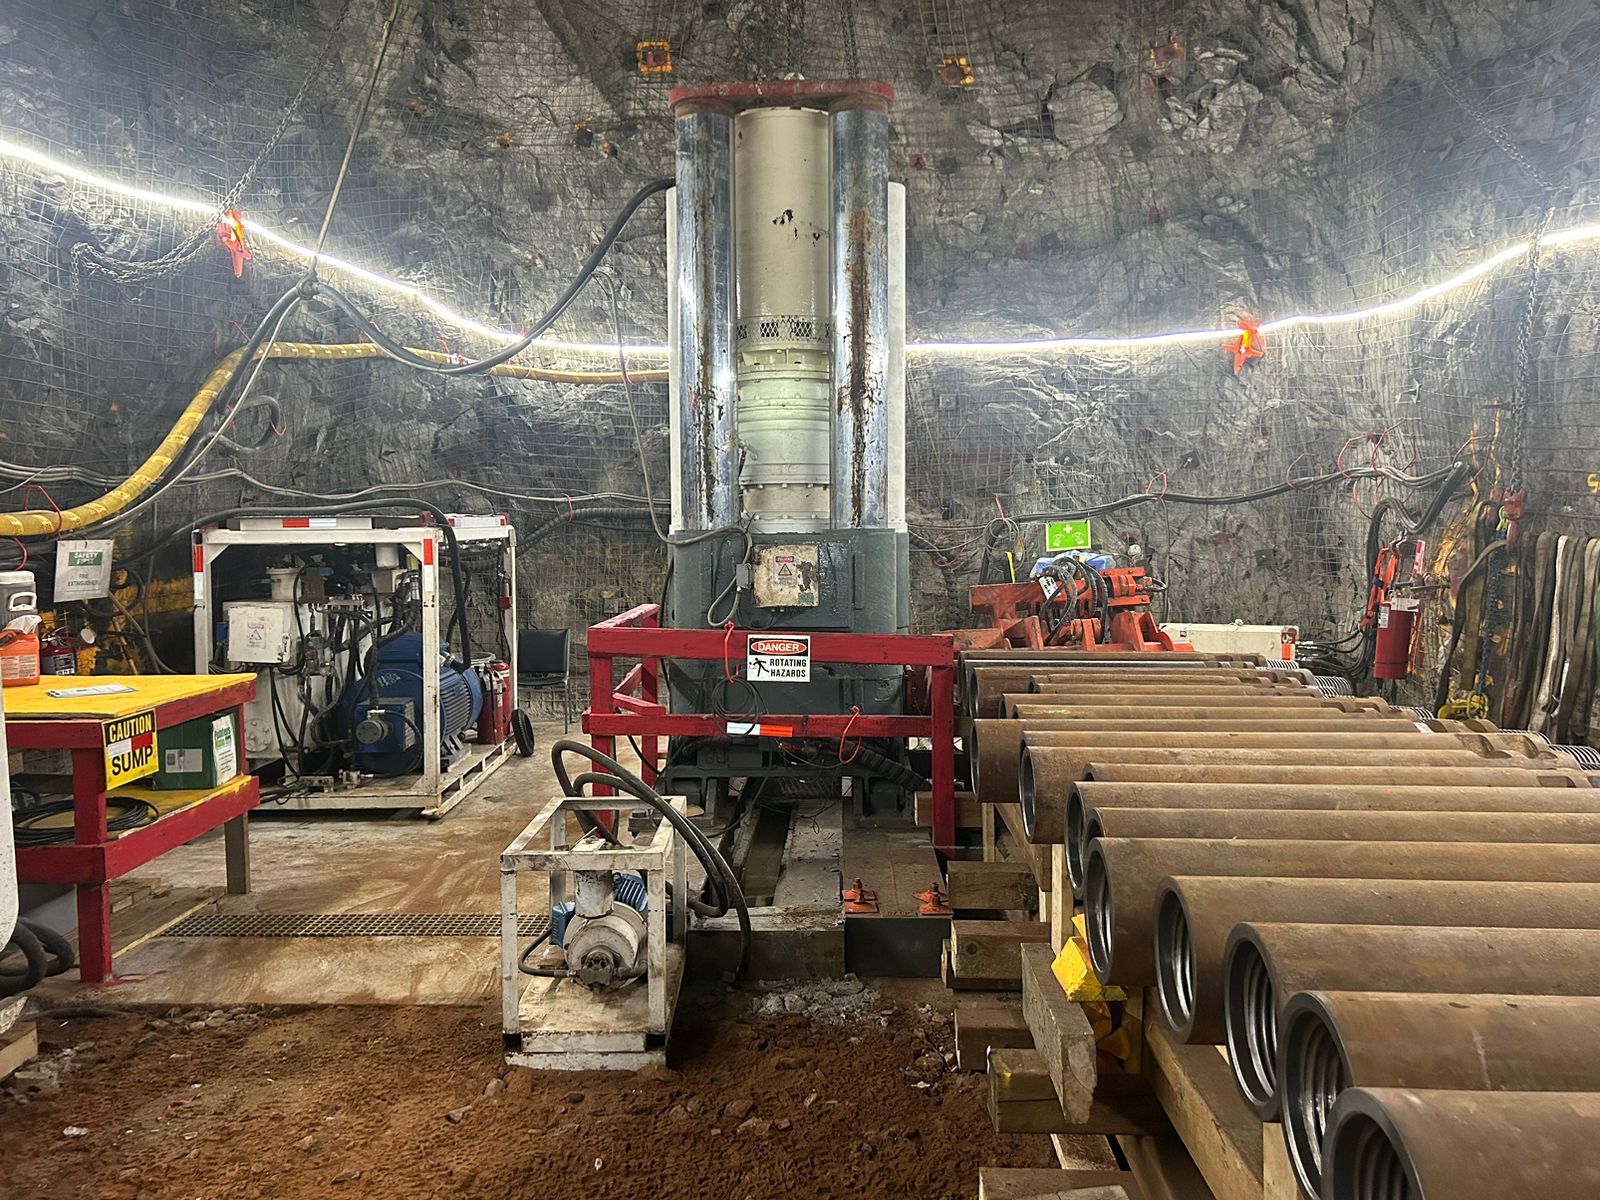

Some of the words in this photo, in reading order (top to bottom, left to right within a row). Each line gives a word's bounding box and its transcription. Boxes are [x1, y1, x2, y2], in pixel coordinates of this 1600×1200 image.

[758, 642, 799, 652] DANGER
[770, 658, 807, 667] ROTATING
[770, 669, 806, 677] HAZARDS
[109, 714, 152, 743] CAUTION
[112, 745, 153, 776] SUMP
